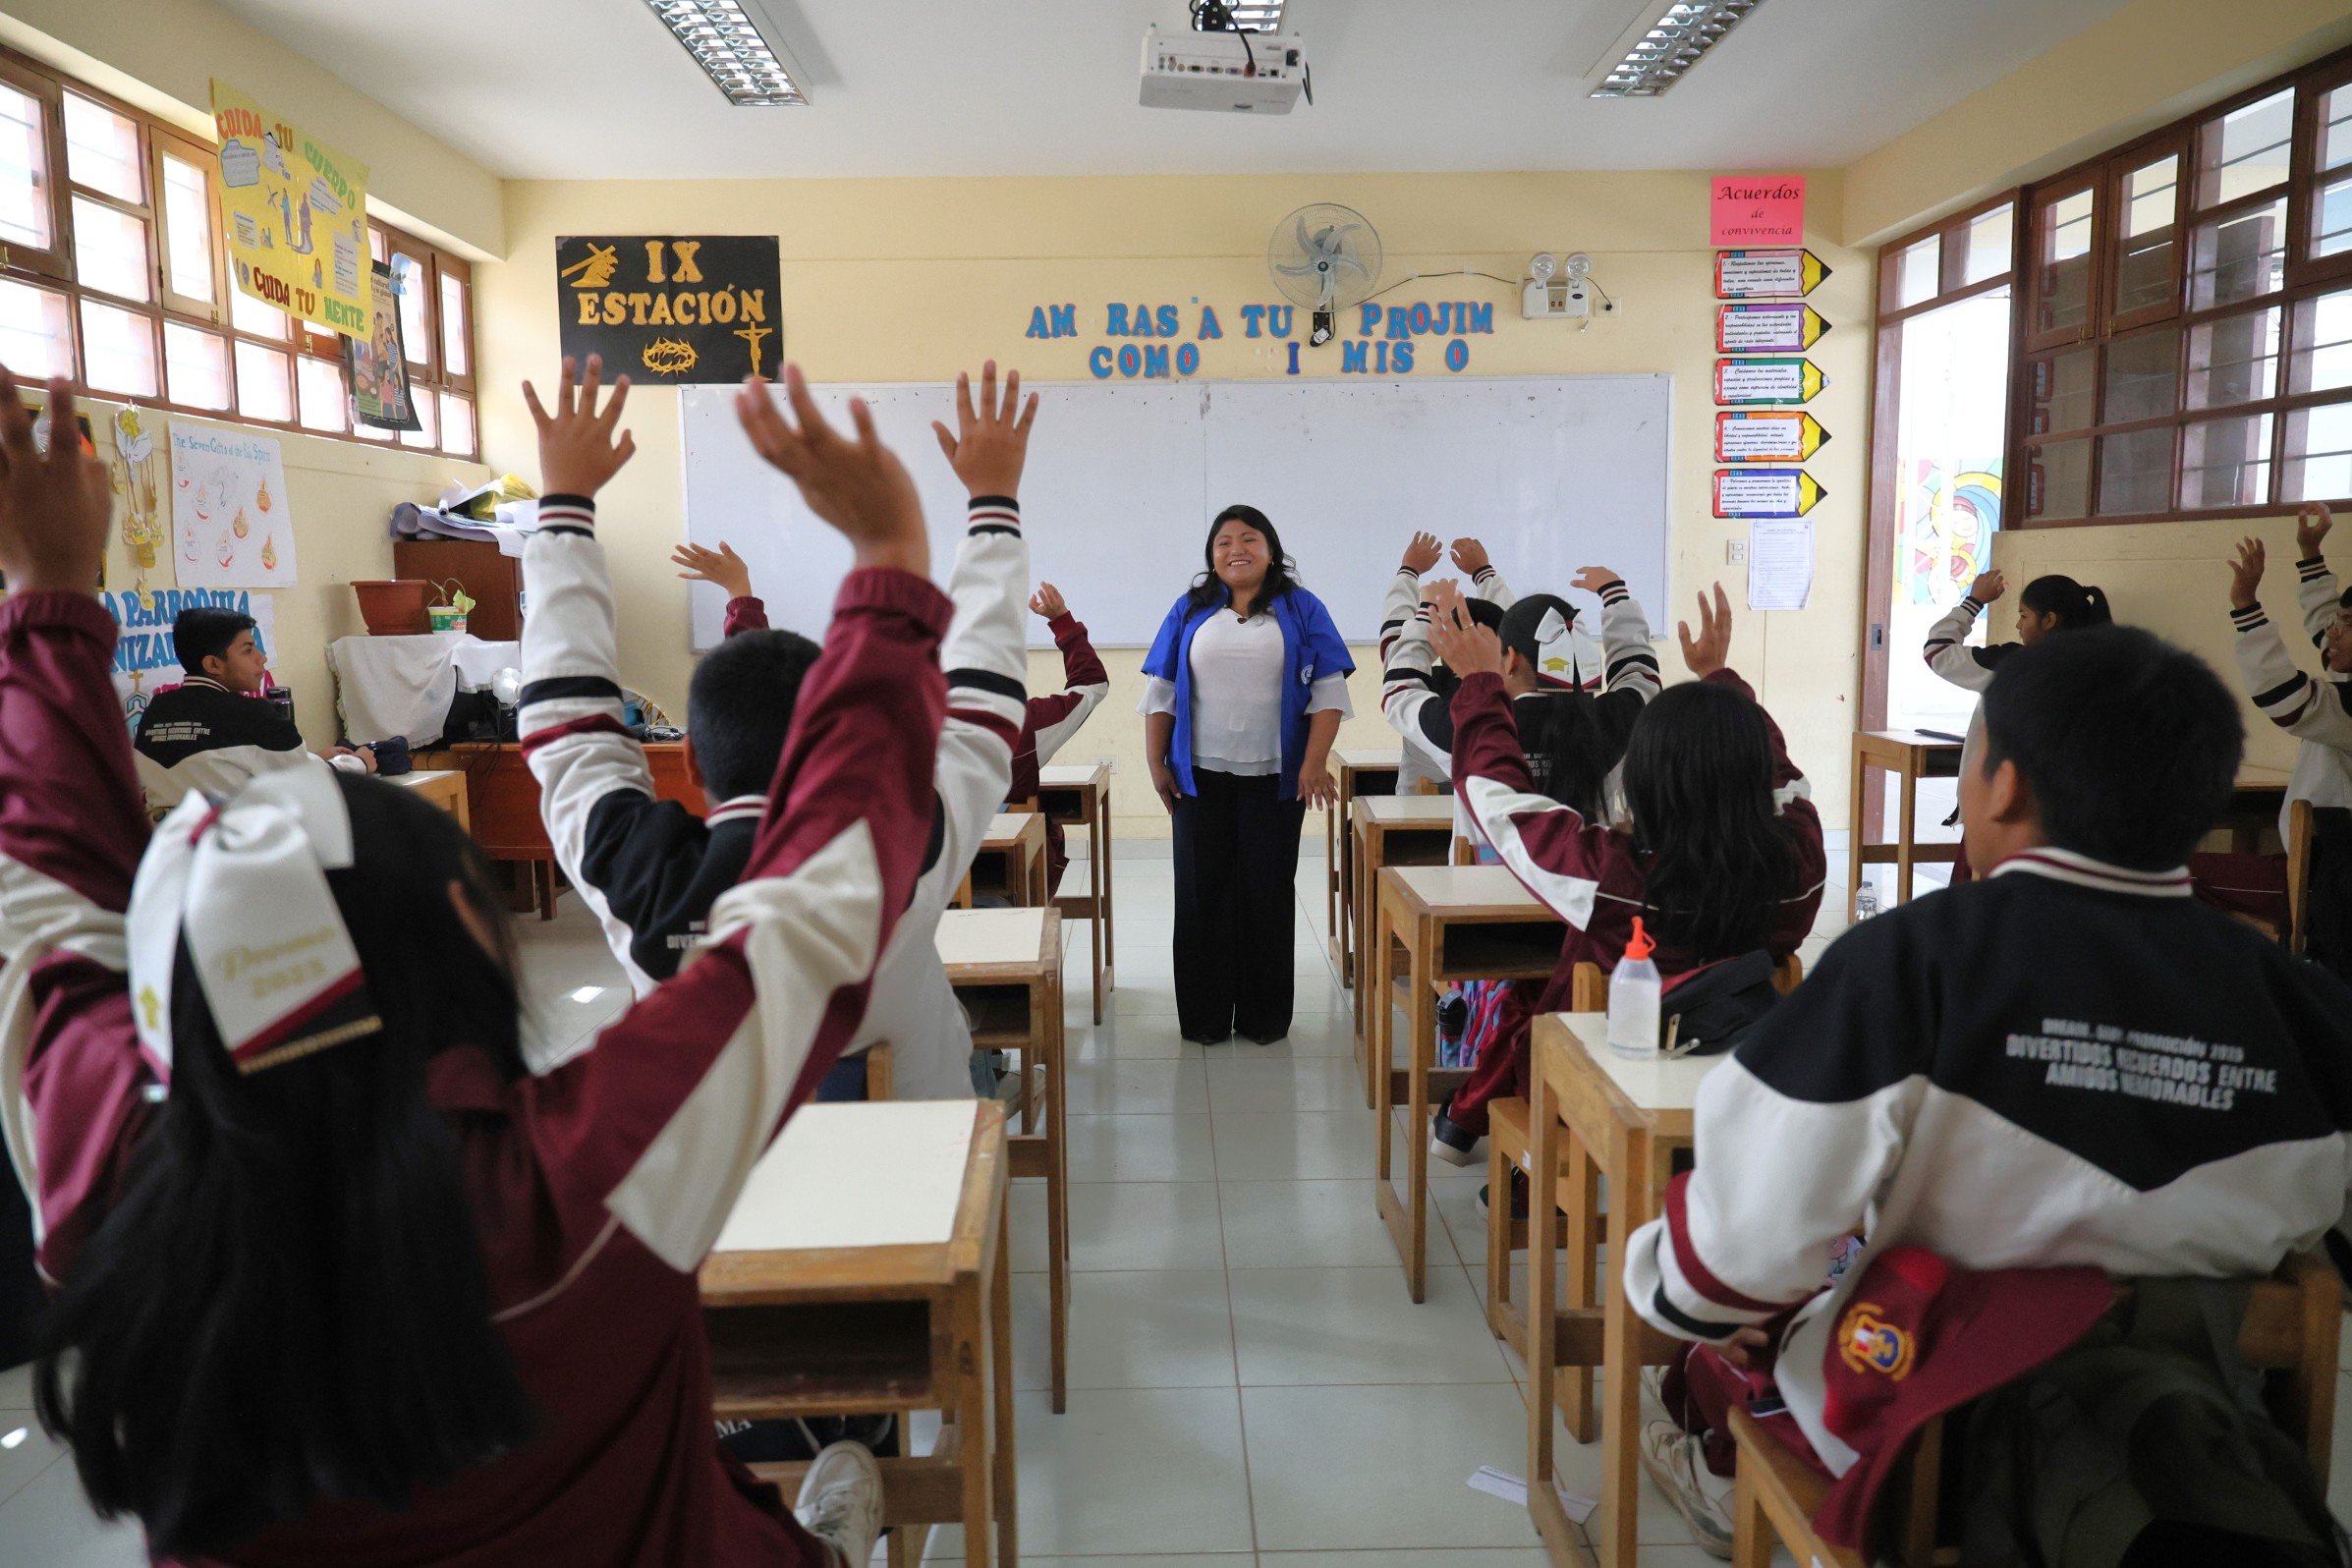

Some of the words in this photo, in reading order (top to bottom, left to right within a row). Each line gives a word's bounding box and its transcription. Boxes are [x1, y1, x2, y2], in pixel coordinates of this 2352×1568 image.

[216, 108, 264, 140] CUIDA
[275, 123, 293, 152] TU
[305, 140, 356, 210] CUERPO
[1717, 184, 1801, 200] Acuerdos
[1721, 225, 1793, 237] convivencia
[1751, 207, 1764, 219] de
[644, 241, 703, 283] IX
[253, 266, 290, 307] CUIDA
[296, 288, 314, 315] TU
[577, 283, 765, 325] ESTACIÓN
[1198, 305, 1223, 340] A
[1240, 304, 1293, 339] TU
[1089, 342, 1200, 379] COMO
[2217, 1064, 2277, 1093] ENTRE
